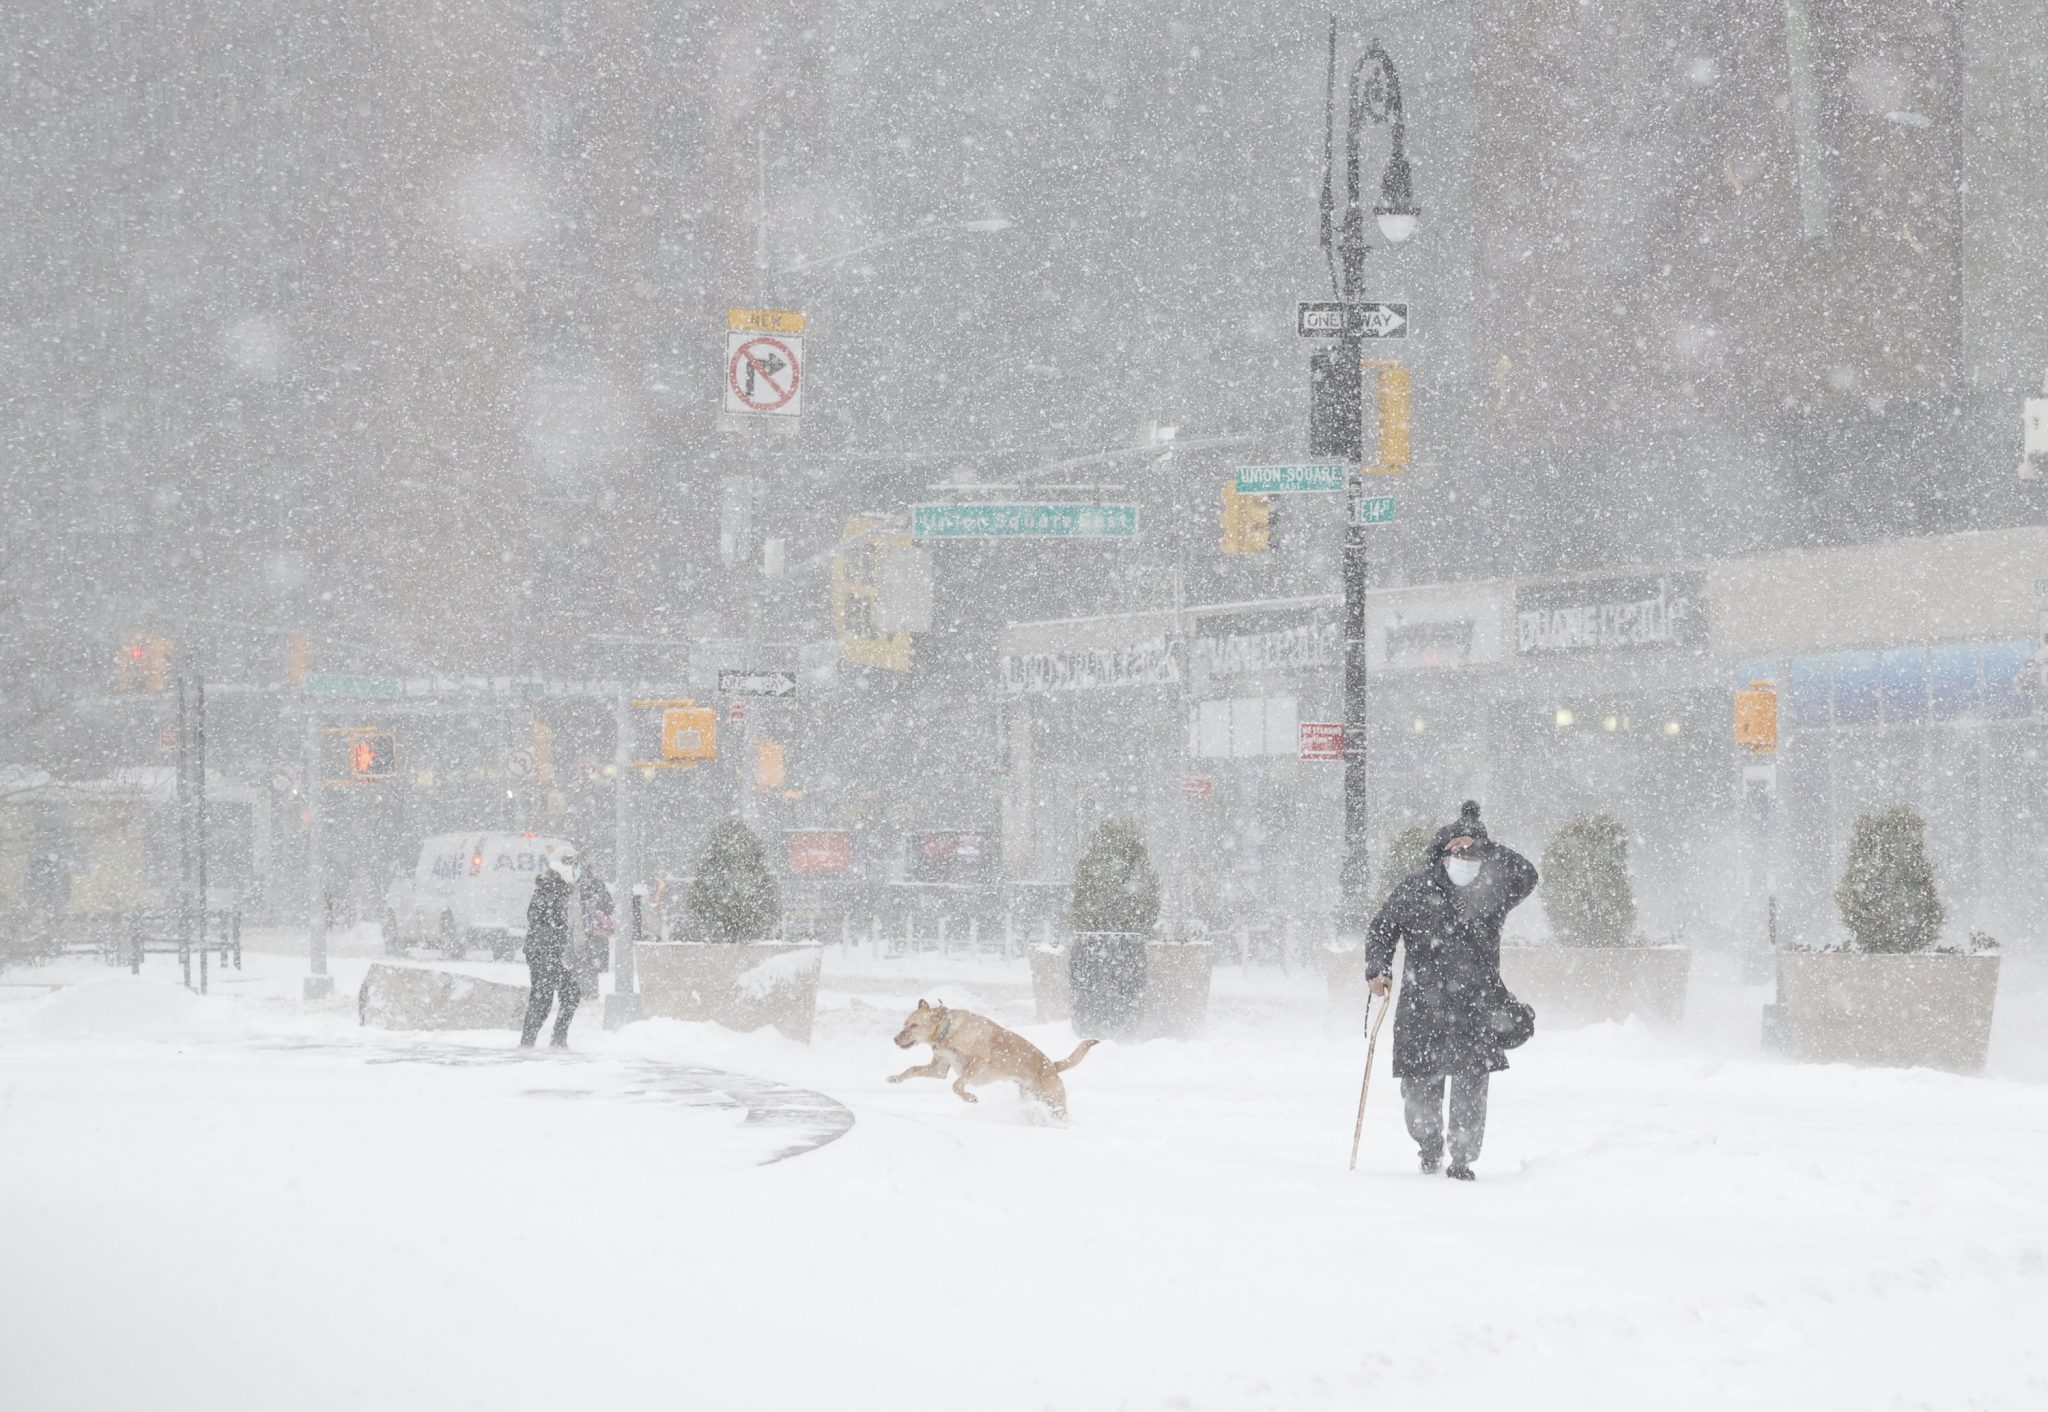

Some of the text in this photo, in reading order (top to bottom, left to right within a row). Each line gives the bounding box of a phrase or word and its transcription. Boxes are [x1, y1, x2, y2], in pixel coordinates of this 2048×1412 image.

[1307, 313, 1392, 328] ONE WAY
[1240, 466, 1337, 483] UNION SQUARE
[1369, 500, 1380, 521] 14
[995, 512, 1072, 530] Square
[1518, 605, 1597, 652] DUANE
